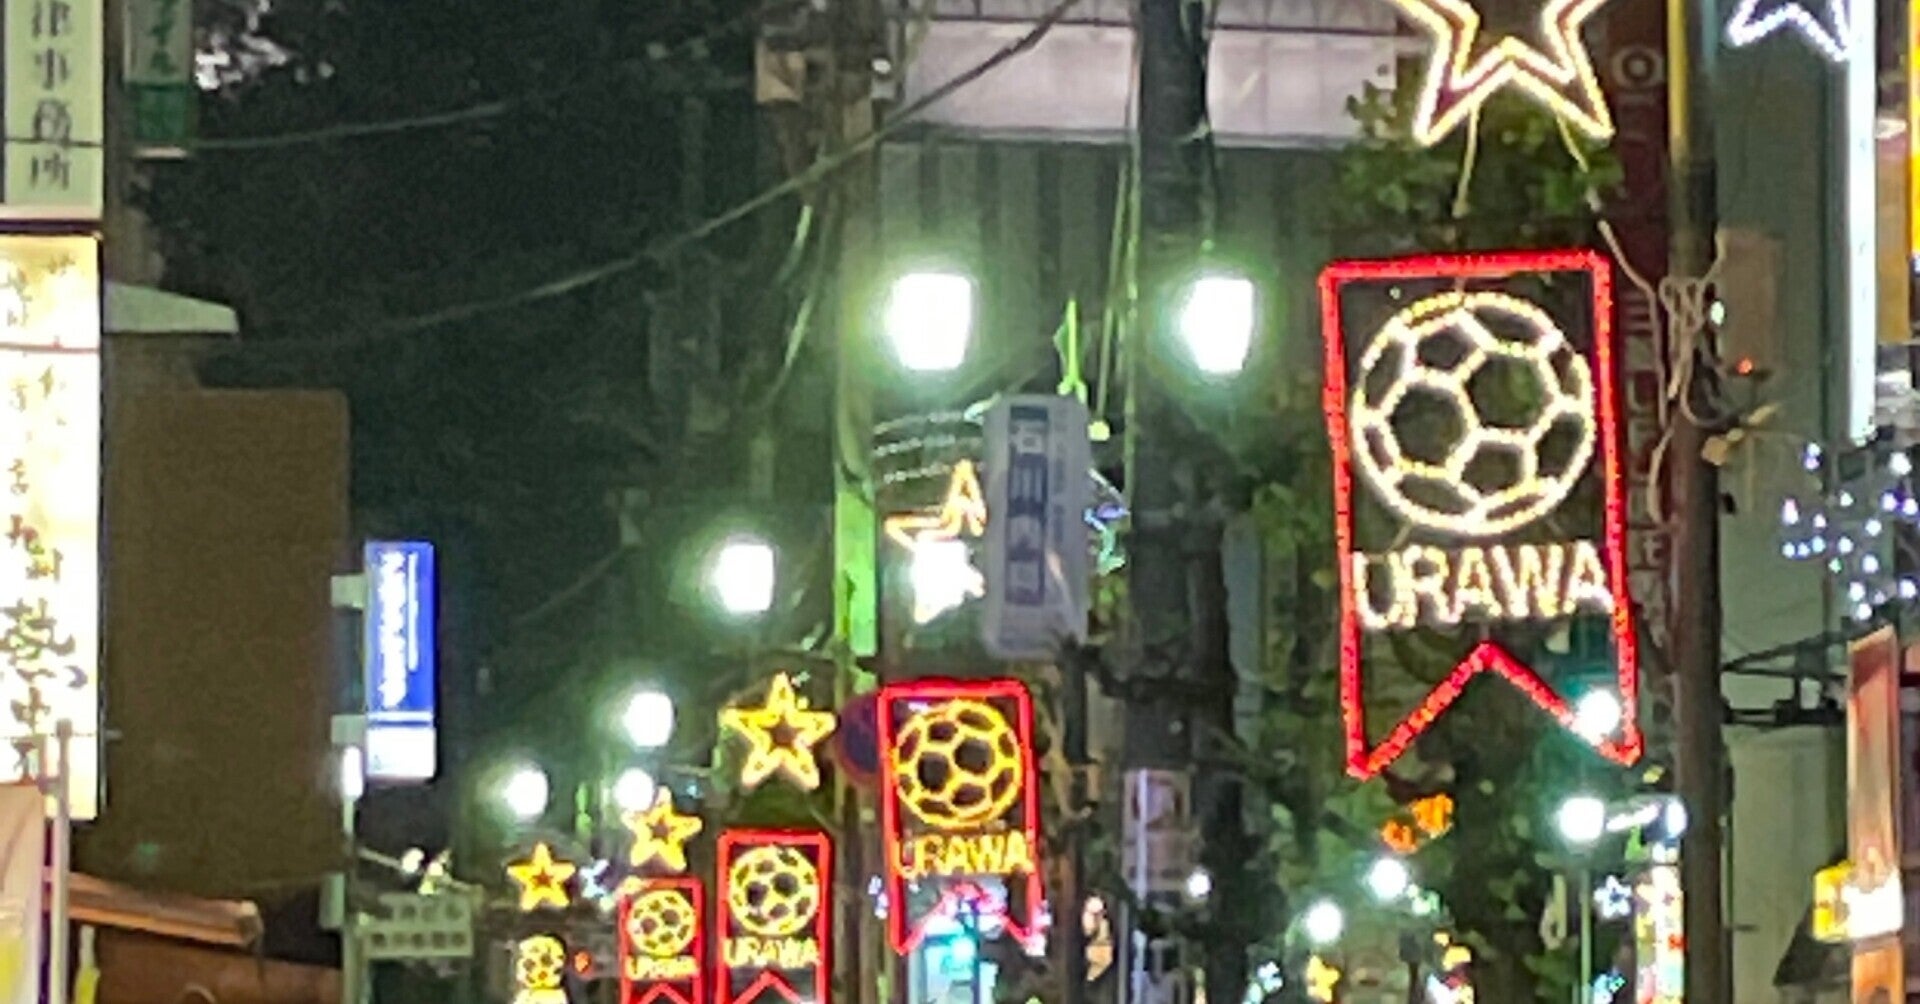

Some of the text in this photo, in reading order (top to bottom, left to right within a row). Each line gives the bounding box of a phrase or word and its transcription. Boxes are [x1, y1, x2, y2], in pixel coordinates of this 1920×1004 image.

[1352, 539, 1614, 628] URAWA
[897, 829, 1036, 879] URAWA
[723, 937, 819, 968] URAWA
